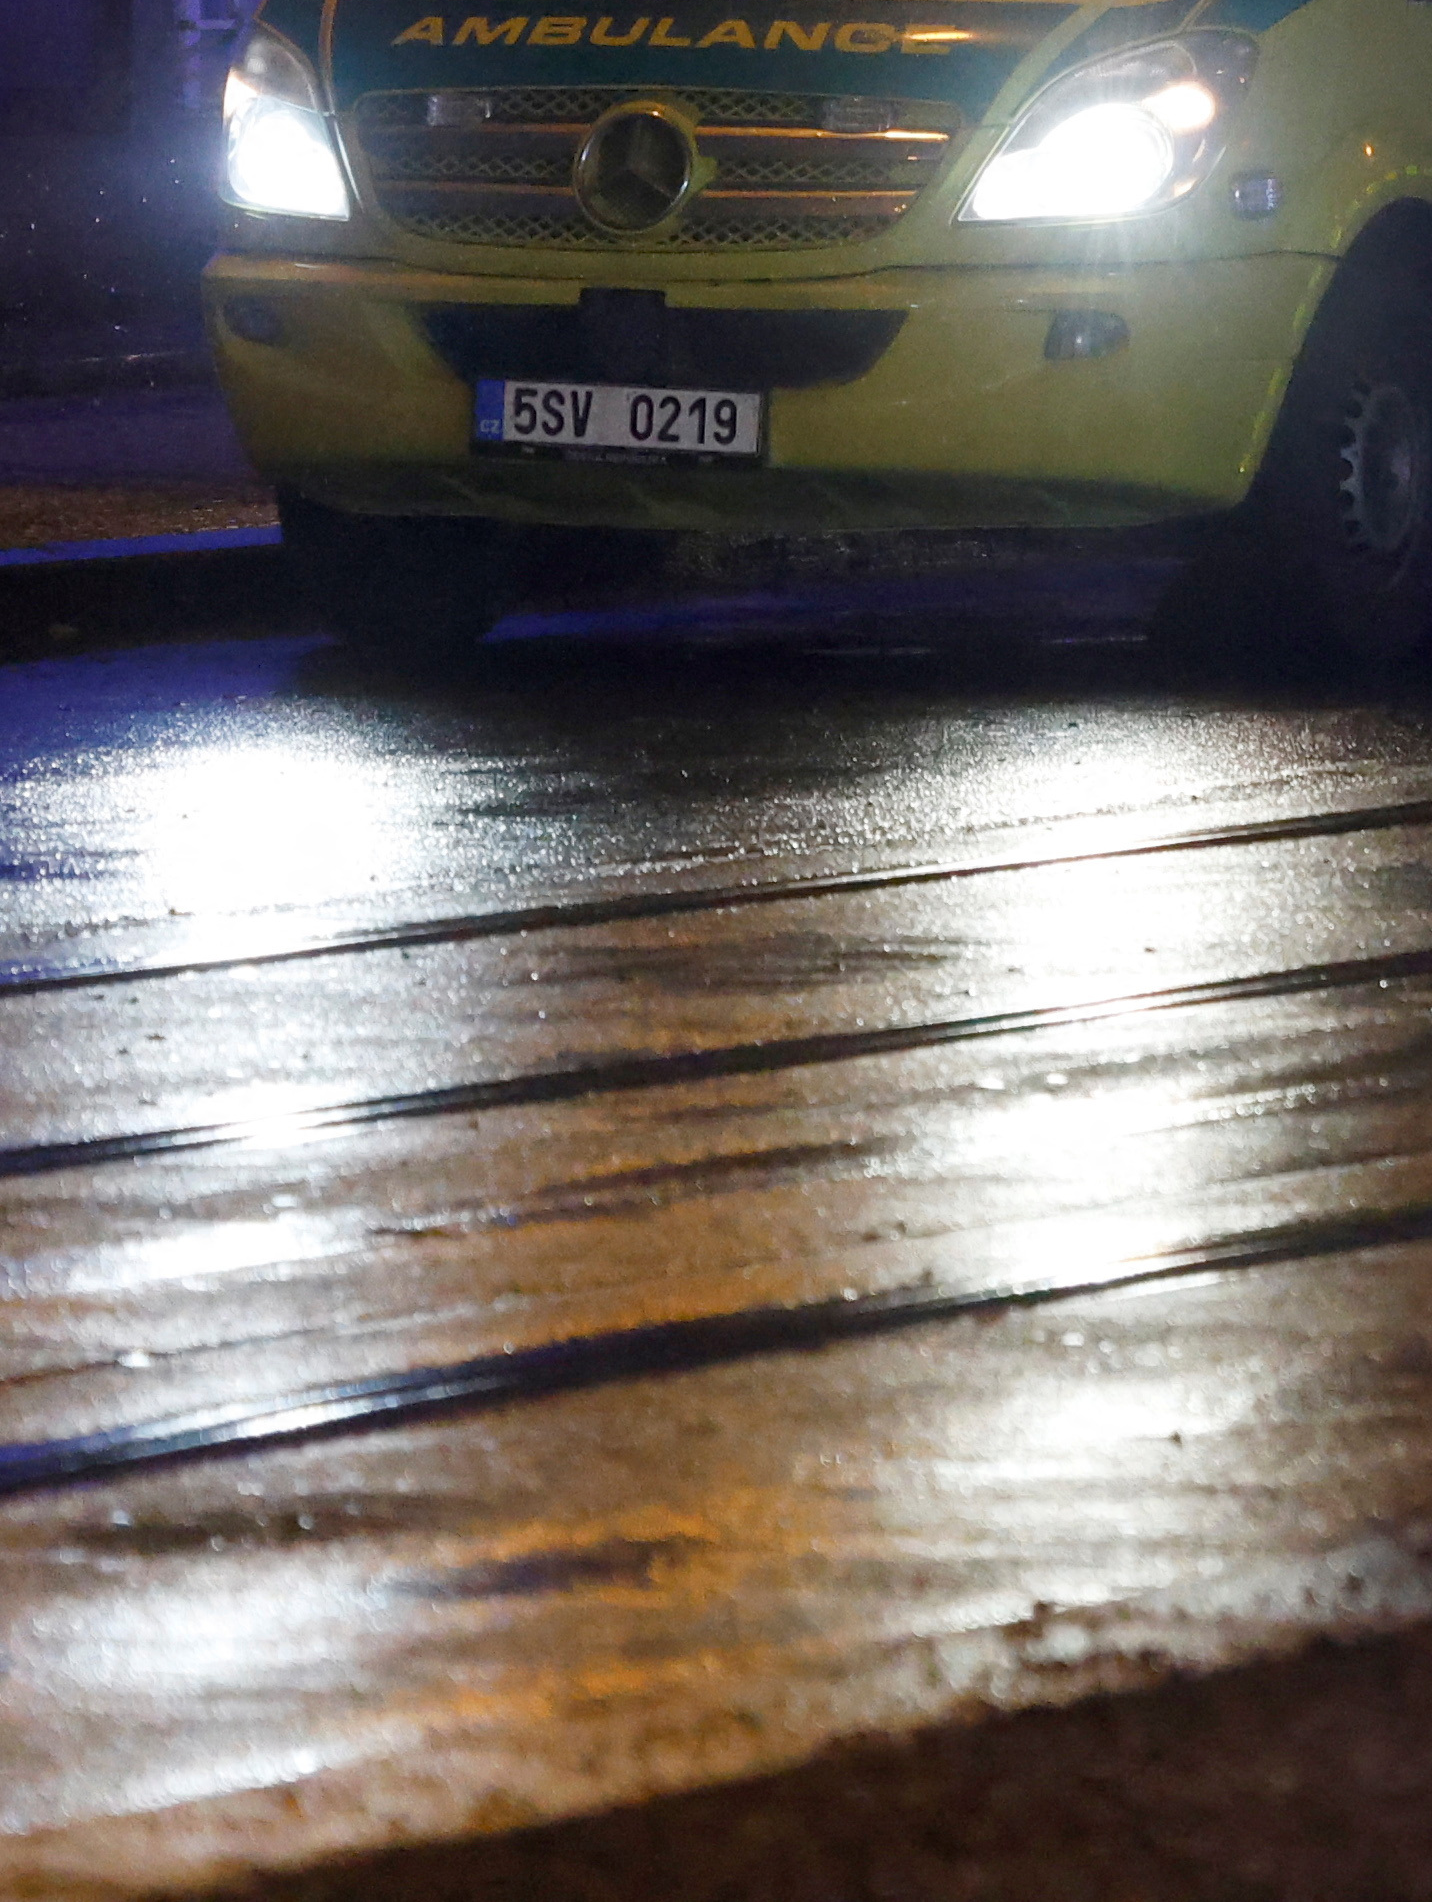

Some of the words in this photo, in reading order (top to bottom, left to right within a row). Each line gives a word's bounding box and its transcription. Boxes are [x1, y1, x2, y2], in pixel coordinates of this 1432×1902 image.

[391, 16, 957, 54] AMBULANCE
[479, 418, 501, 434] CZ
[513, 387, 593, 438] 5SV
[629, 394, 738, 445] 0219
